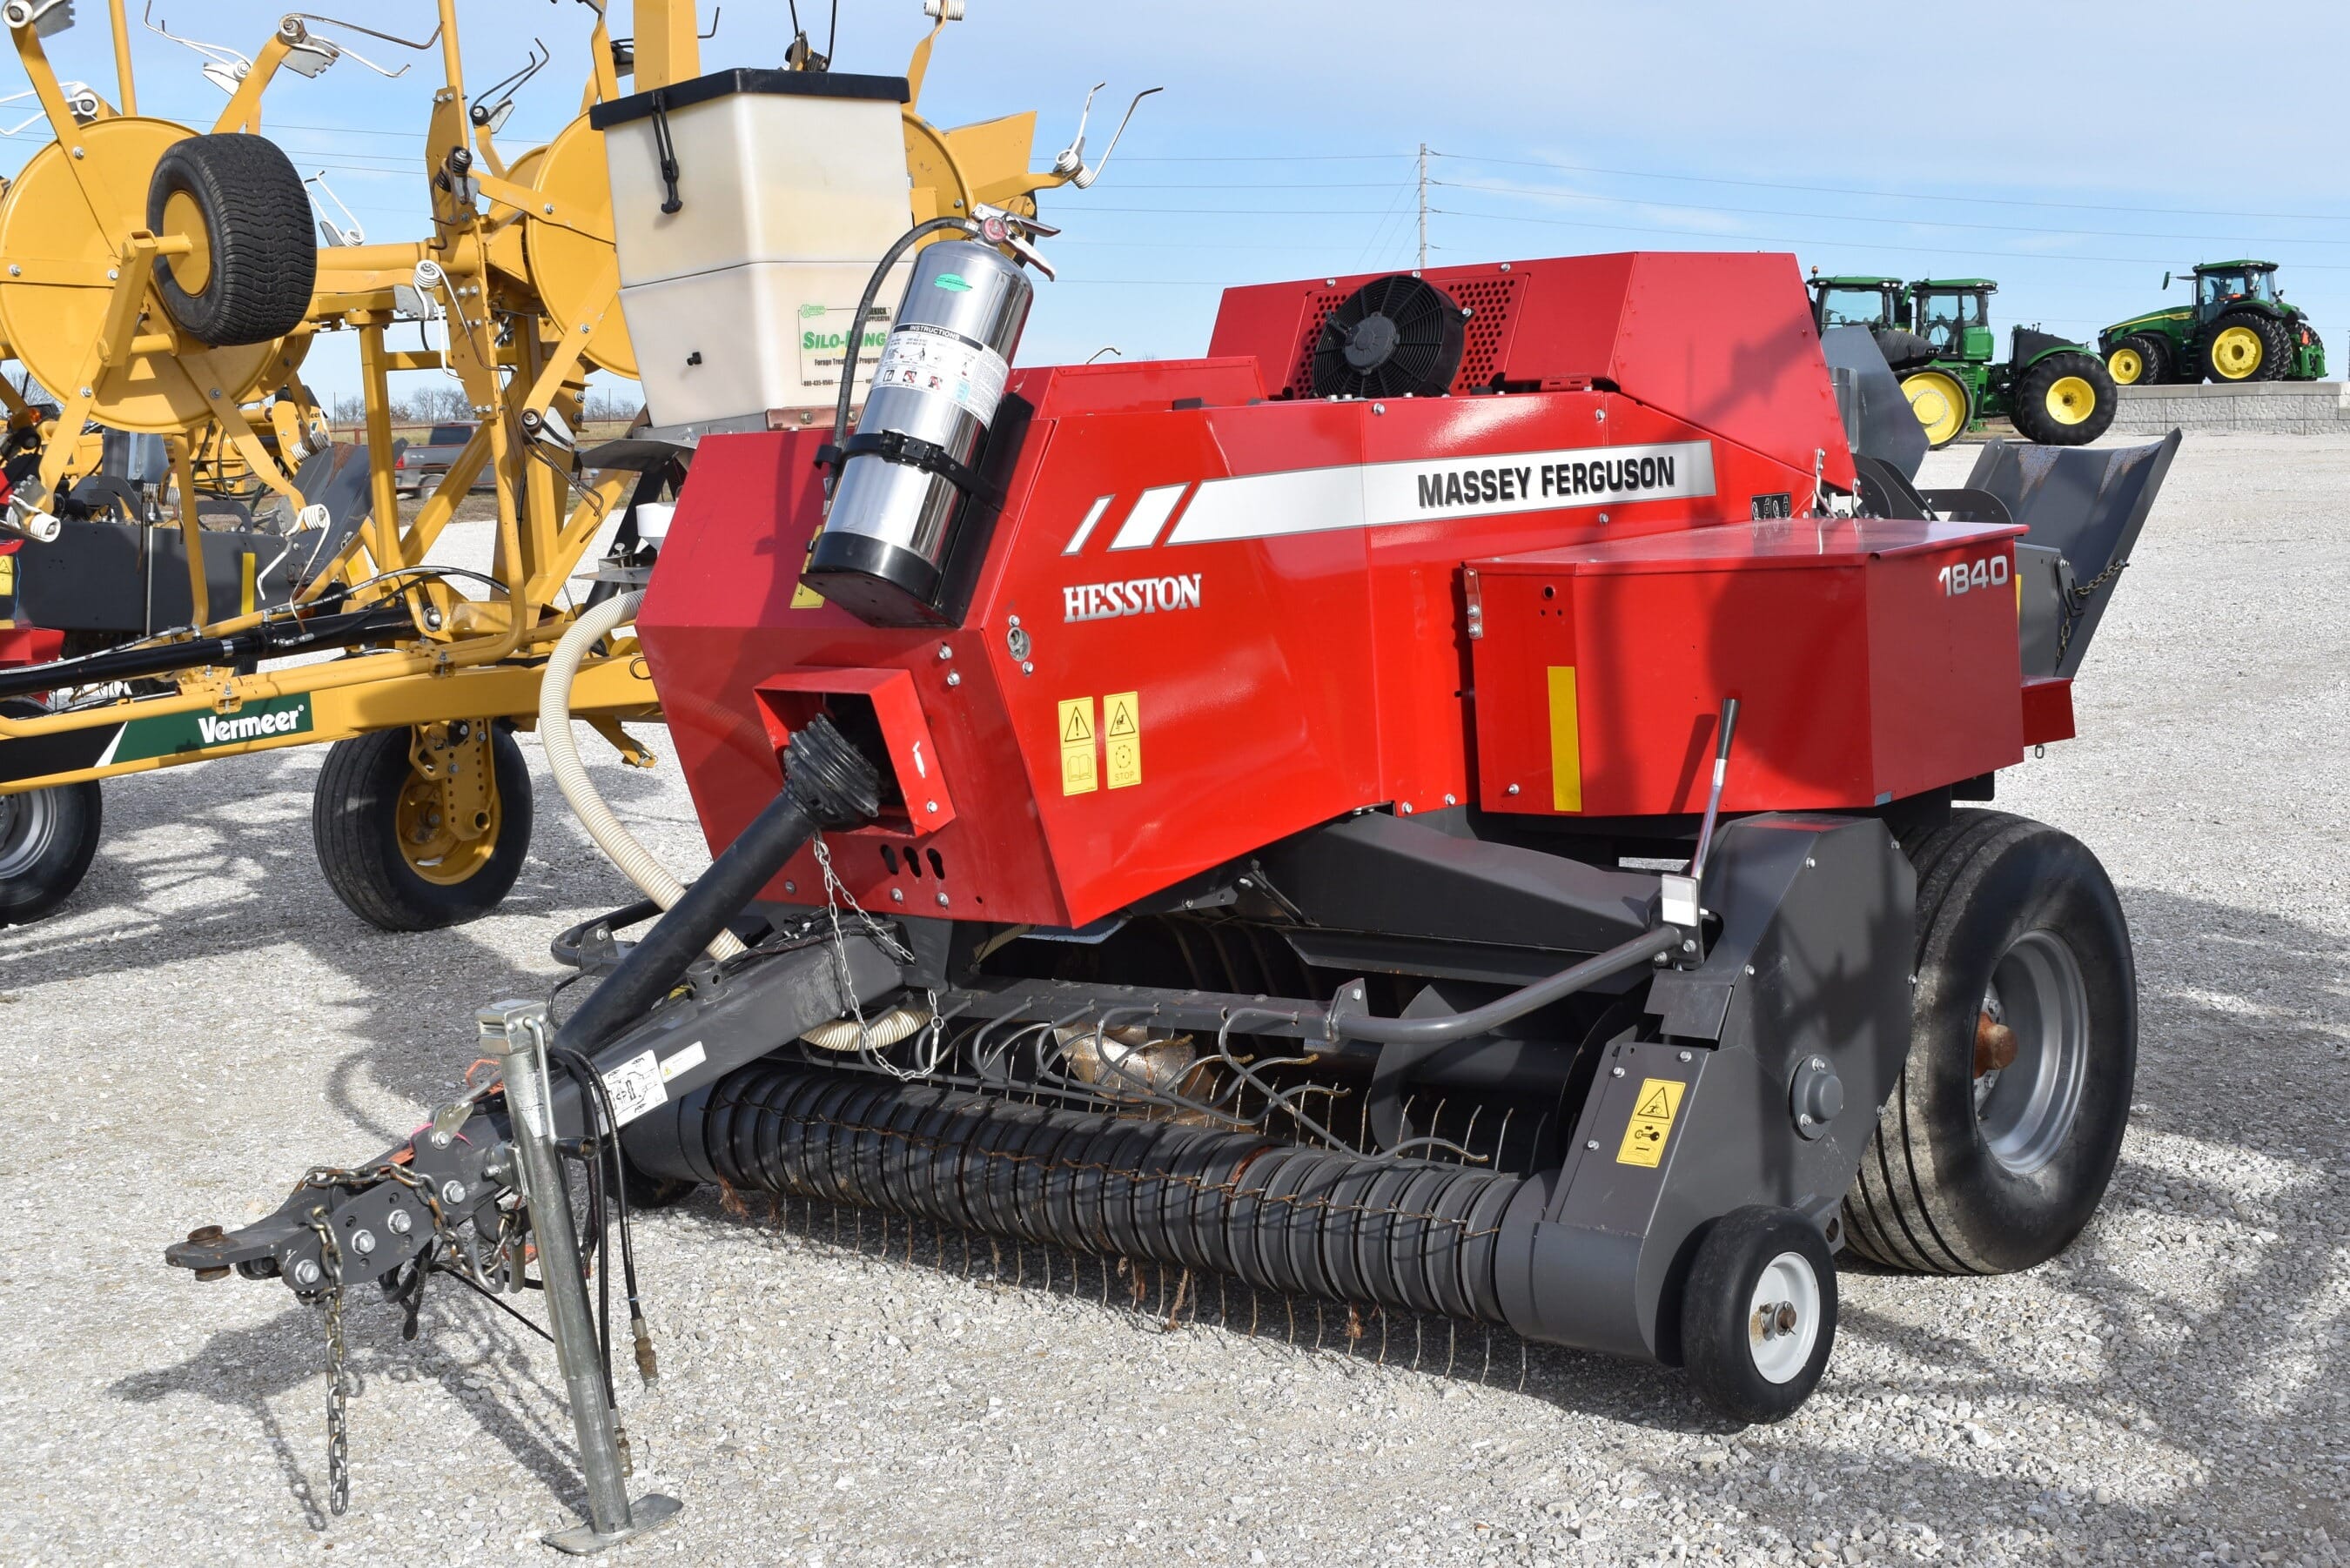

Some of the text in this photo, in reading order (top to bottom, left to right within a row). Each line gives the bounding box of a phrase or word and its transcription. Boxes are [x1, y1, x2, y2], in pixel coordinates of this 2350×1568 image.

[910, 325, 961, 341] INSTRUCTIONS
[814, 358, 832, 366] Forage
[1417, 456, 1675, 509] MASSEY FERGUSON
[1938, 555, 2008, 598] 1840
[1063, 573, 1202, 623] HESSTON
[1114, 771, 1135, 781] STOP
